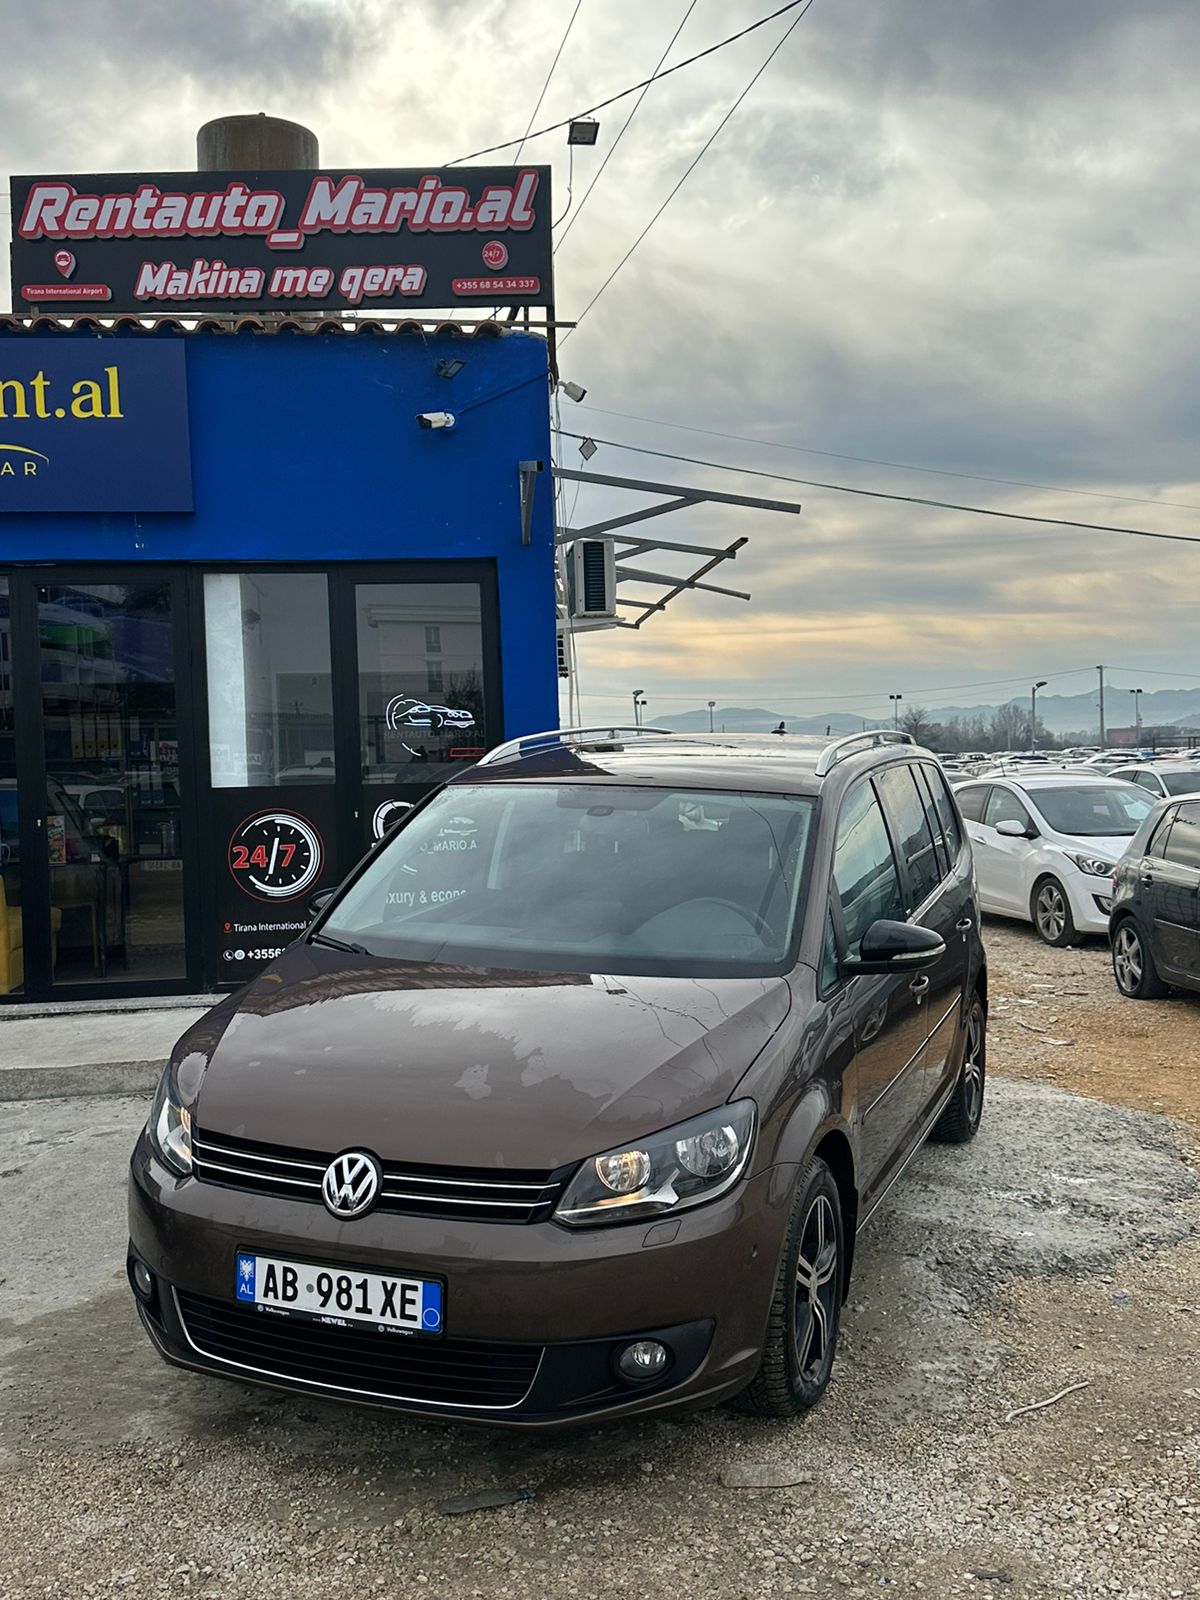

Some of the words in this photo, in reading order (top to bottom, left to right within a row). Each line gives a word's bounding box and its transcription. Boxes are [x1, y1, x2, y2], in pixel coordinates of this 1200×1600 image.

[20, 171, 538, 246] Rentauto_Mario.al
[484, 248, 500, 260] 24/7
[135, 259, 264, 298] Makina
[268, 266, 334, 296] me
[338, 264, 427, 301] qera
[456, 281, 478, 290] +355
[505, 280, 517, 288] 34
[518, 279, 535, 288] 337
[26, 288, 45, 296] Tirana
[82, 287, 103, 296] Airport
[232, 837, 297, 875] 24/7
[385, 891, 416, 907] xury
[419, 890, 428, 904] &
[431, 889, 467, 902] econ
[233, 923, 258, 932] Tirana
[258, 921, 307, 931] International
[247, 948, 286, 960] +3556
[239, 1283, 254, 1295] AL
[262, 1263, 299, 1302] AB
[316, 1272, 373, 1316] 981
[379, 1281, 420, 1322] XE
